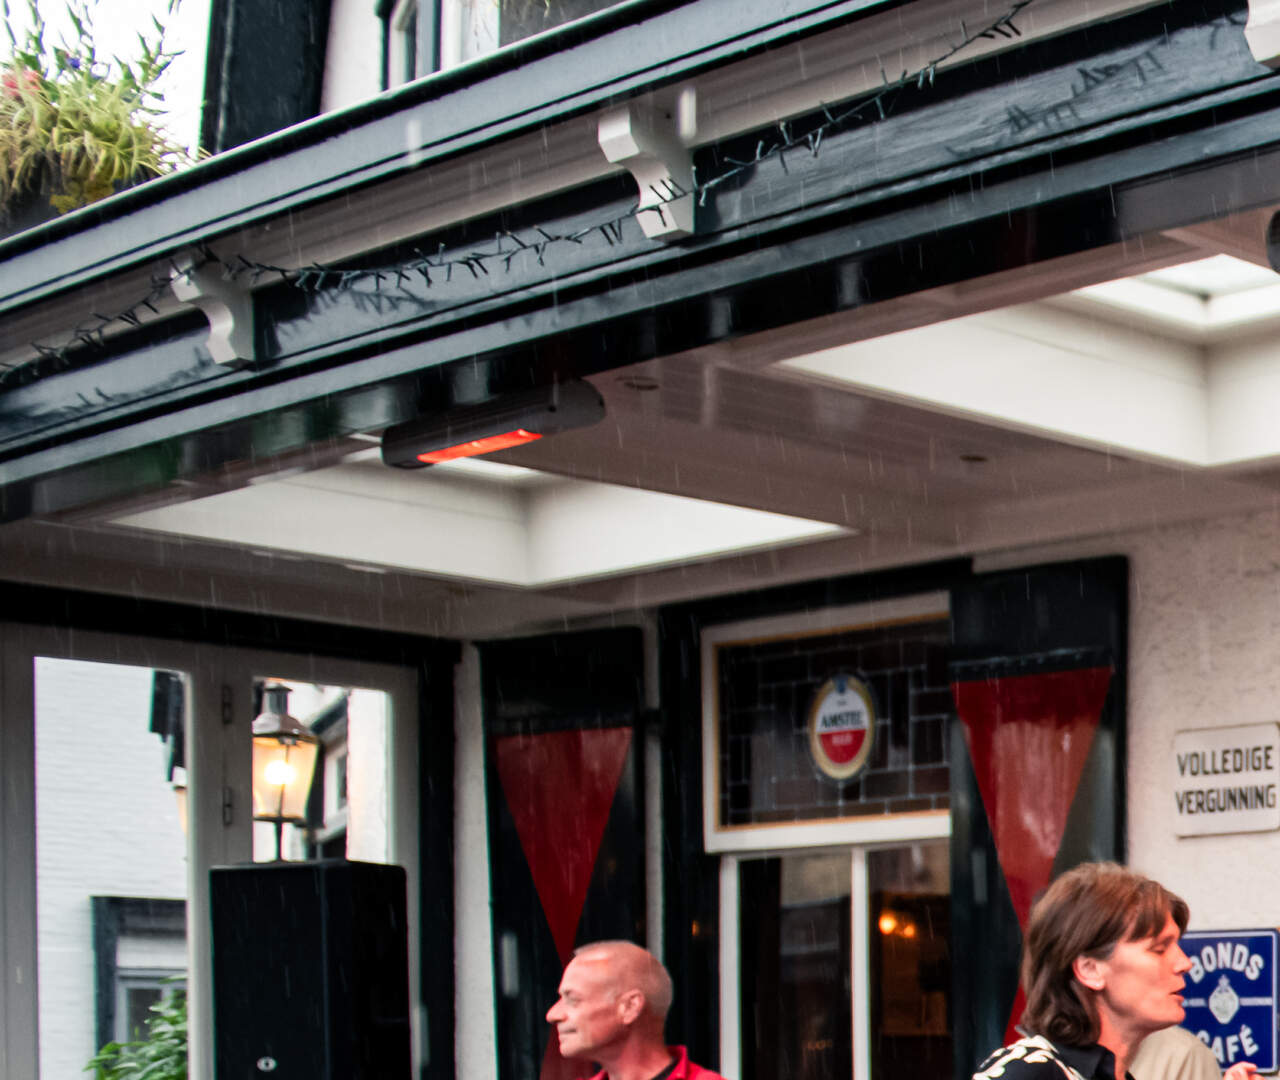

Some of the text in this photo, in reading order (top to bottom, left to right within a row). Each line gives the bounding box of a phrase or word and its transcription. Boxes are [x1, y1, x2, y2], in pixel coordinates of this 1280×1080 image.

[1176, 745, 1274, 777] VOLLEDIGE
[1175, 783, 1277, 815] VERGUNNING
[1189, 942, 1264, 984] BONDS
